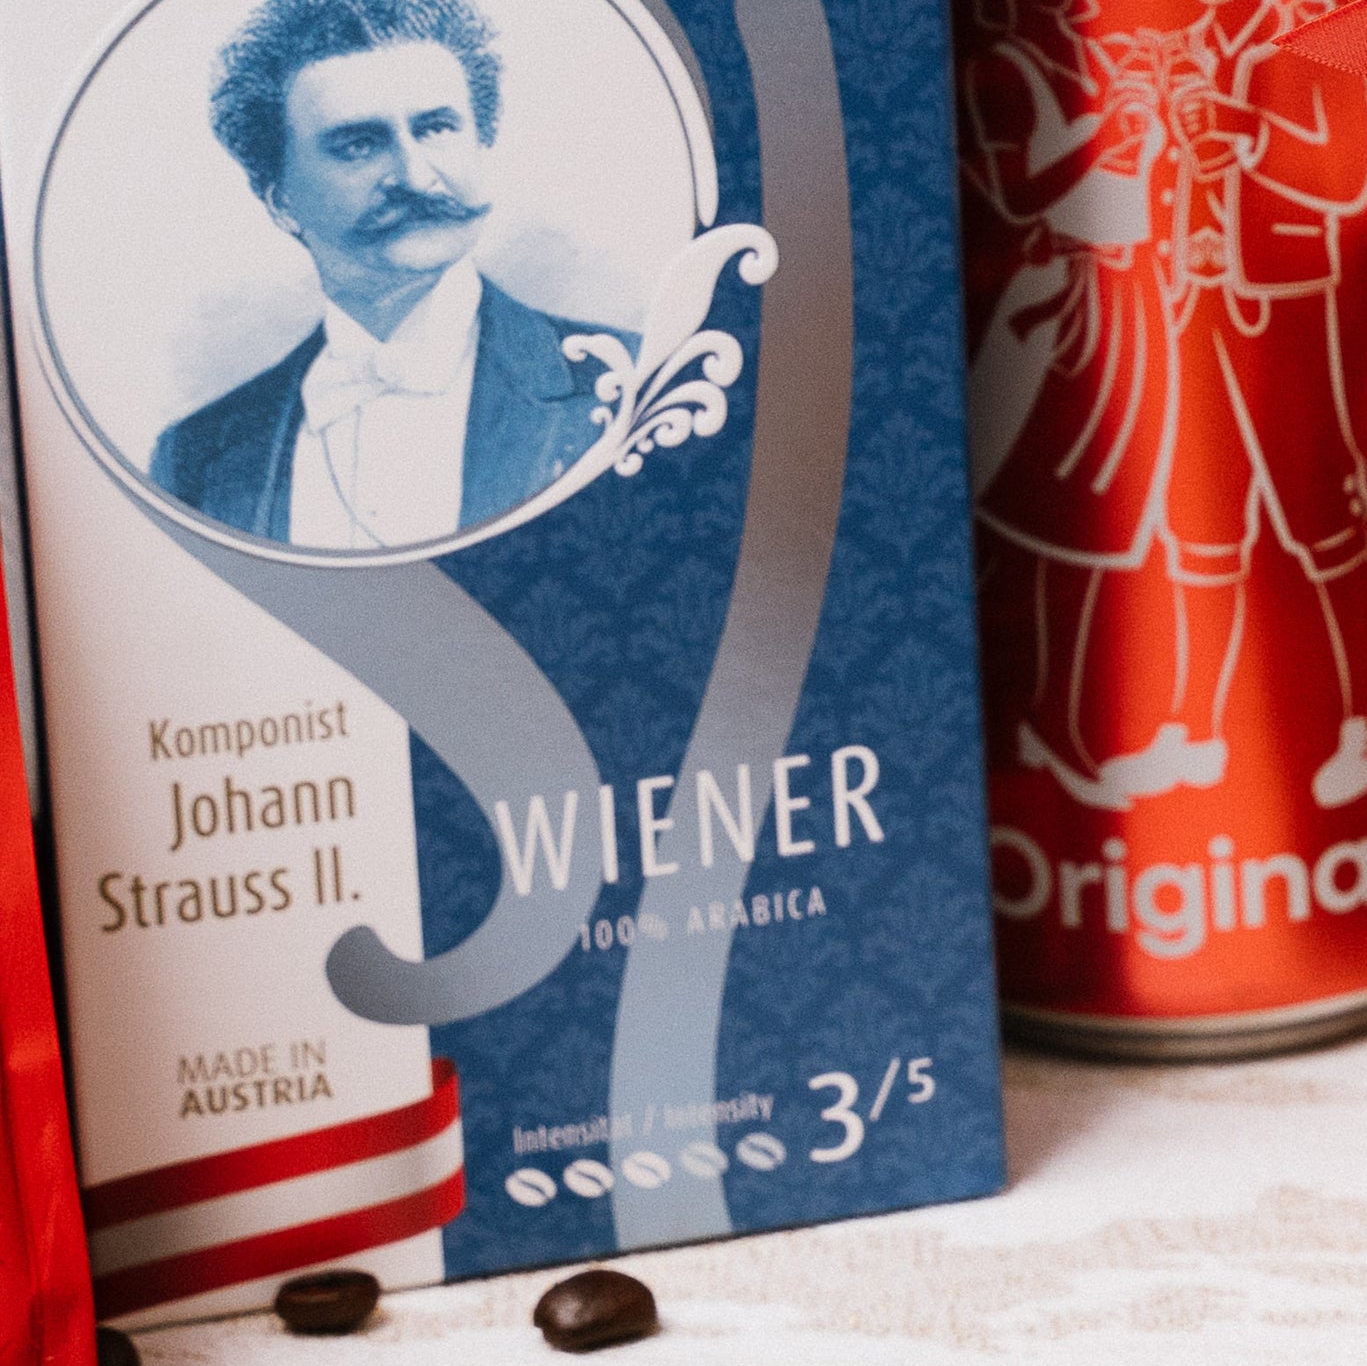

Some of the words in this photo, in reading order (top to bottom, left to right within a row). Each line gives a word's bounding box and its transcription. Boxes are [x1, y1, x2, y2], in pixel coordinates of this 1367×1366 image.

[149, 699, 349, 762] Komponist
[170, 775, 357, 852] Johann
[494, 744, 886, 897] WIENER
[99, 867, 293, 933] Strauss
[580, 913, 669, 952] 100%
[686, 885, 827, 936] ARABICA
[177, 1042, 278, 1085] MADE
[289, 1039, 328, 1069] IN
[179, 1071, 334, 1121] AUSTRIA
